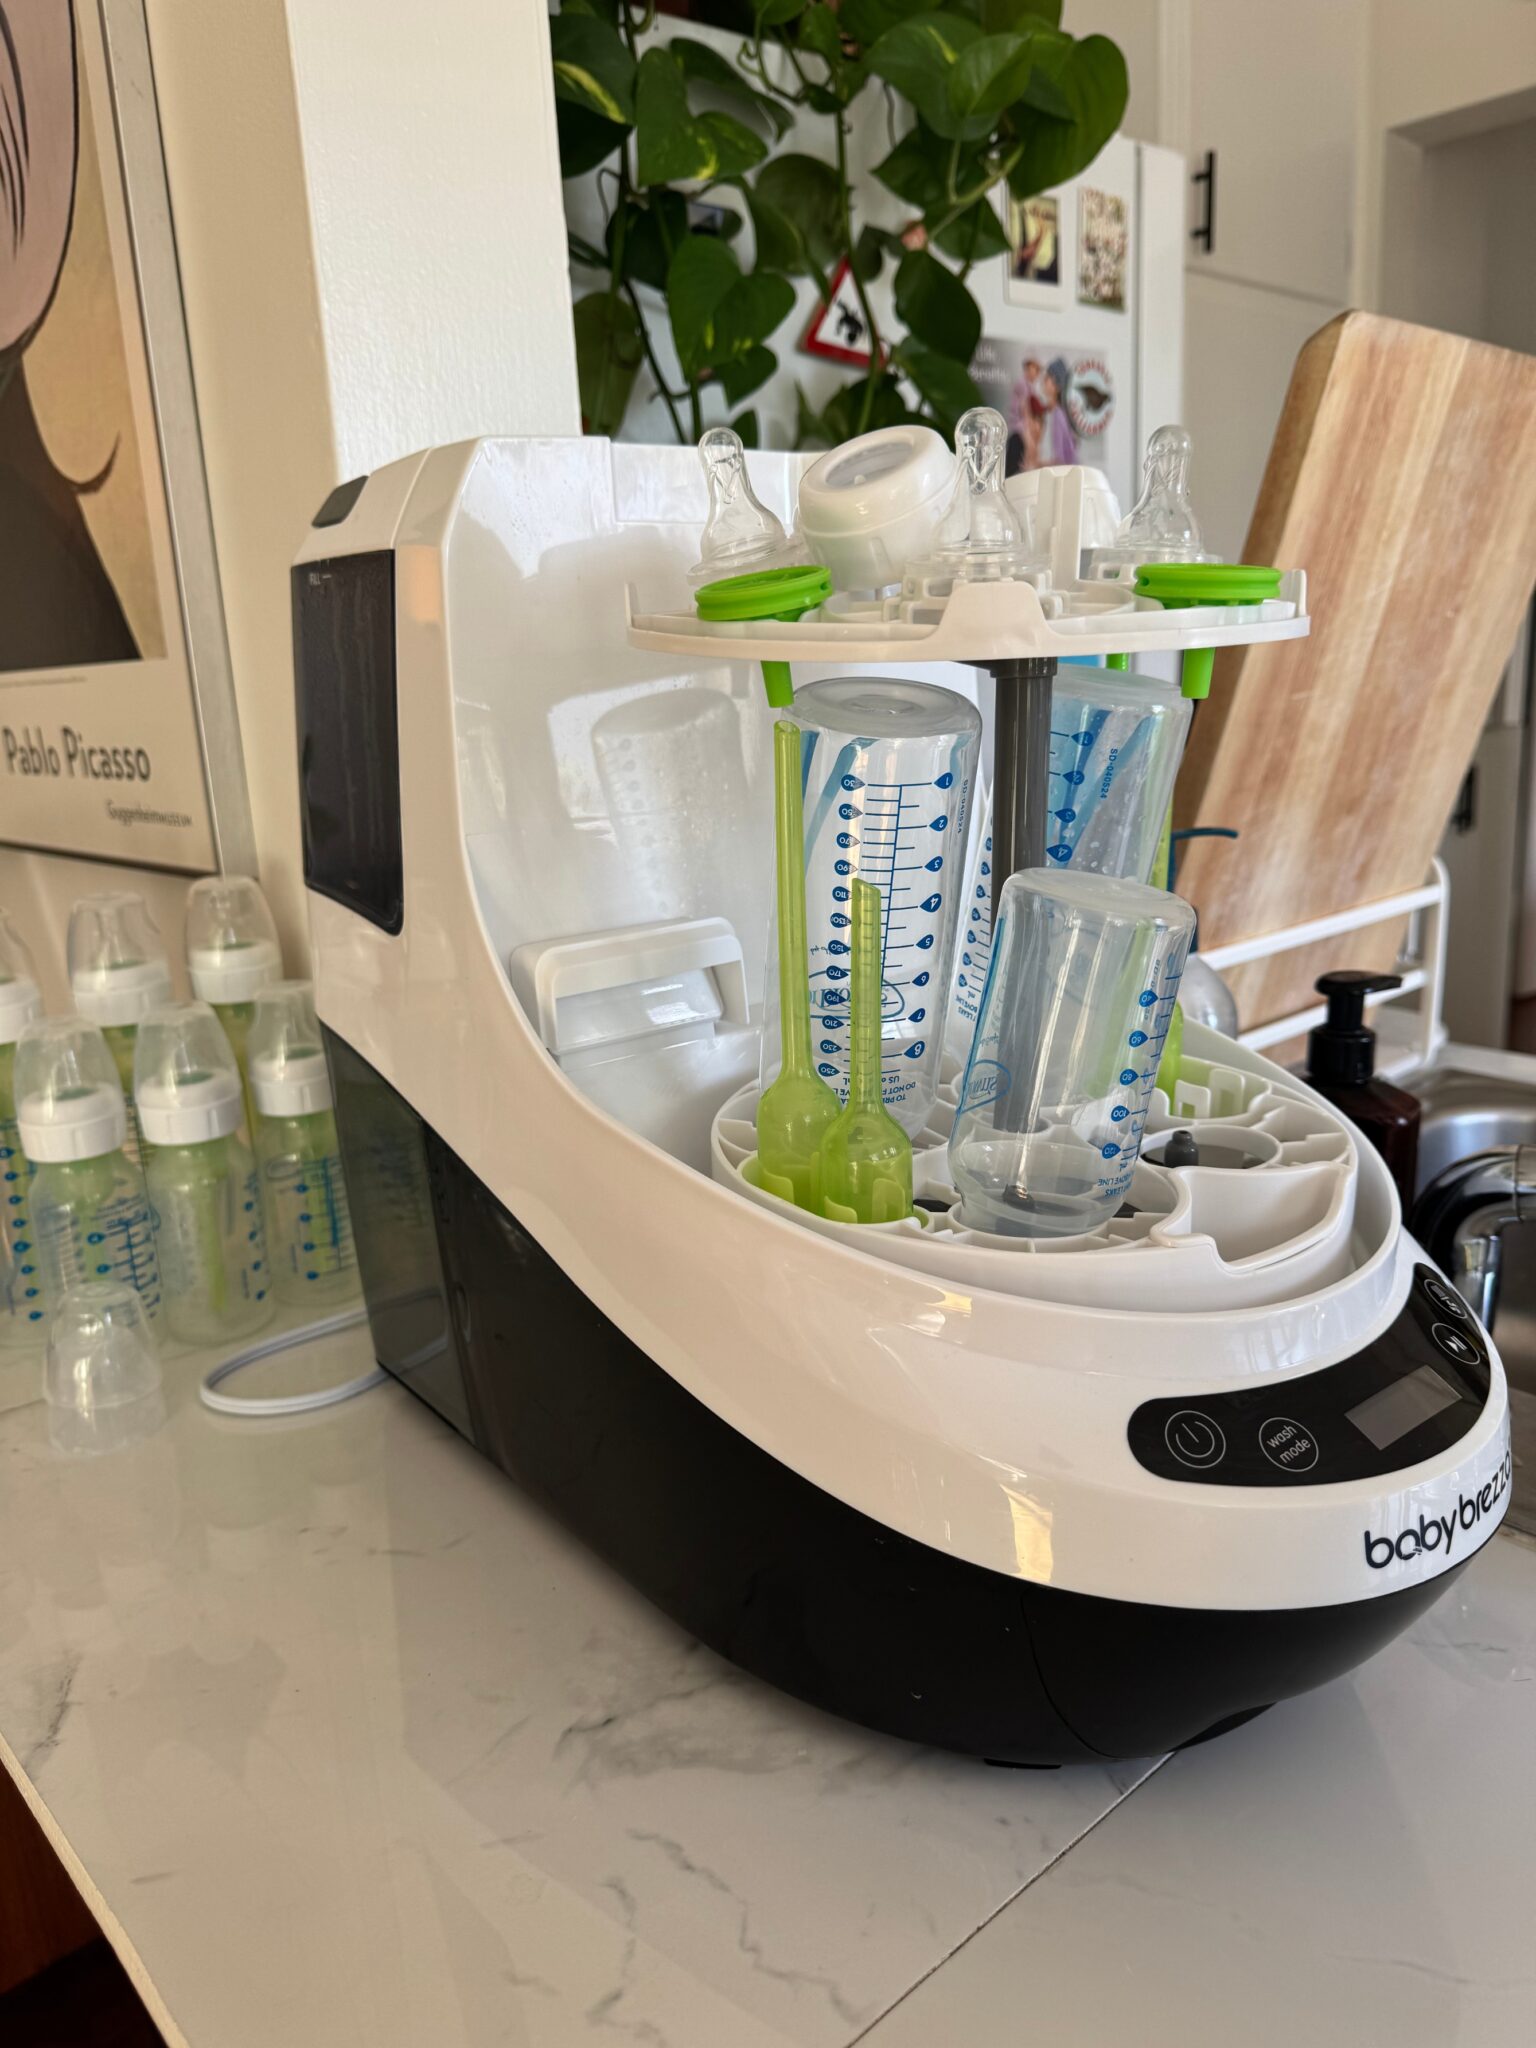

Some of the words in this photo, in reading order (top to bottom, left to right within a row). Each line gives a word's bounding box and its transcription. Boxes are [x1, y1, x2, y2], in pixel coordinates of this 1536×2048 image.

[2, 725, 61, 777] Pablo
[61, 725, 151, 782] Picasso
[1100, 747, 1118, 799] SD-040524
[888, 1075, 900, 1084] US
[905, 1081, 916, 1091] DO
[887, 1085, 905, 1095] NOT
[895, 1093, 906, 1102] TO
[1266, 1425, 1298, 1448] wash
[1280, 1440, 1311, 1463] mode
